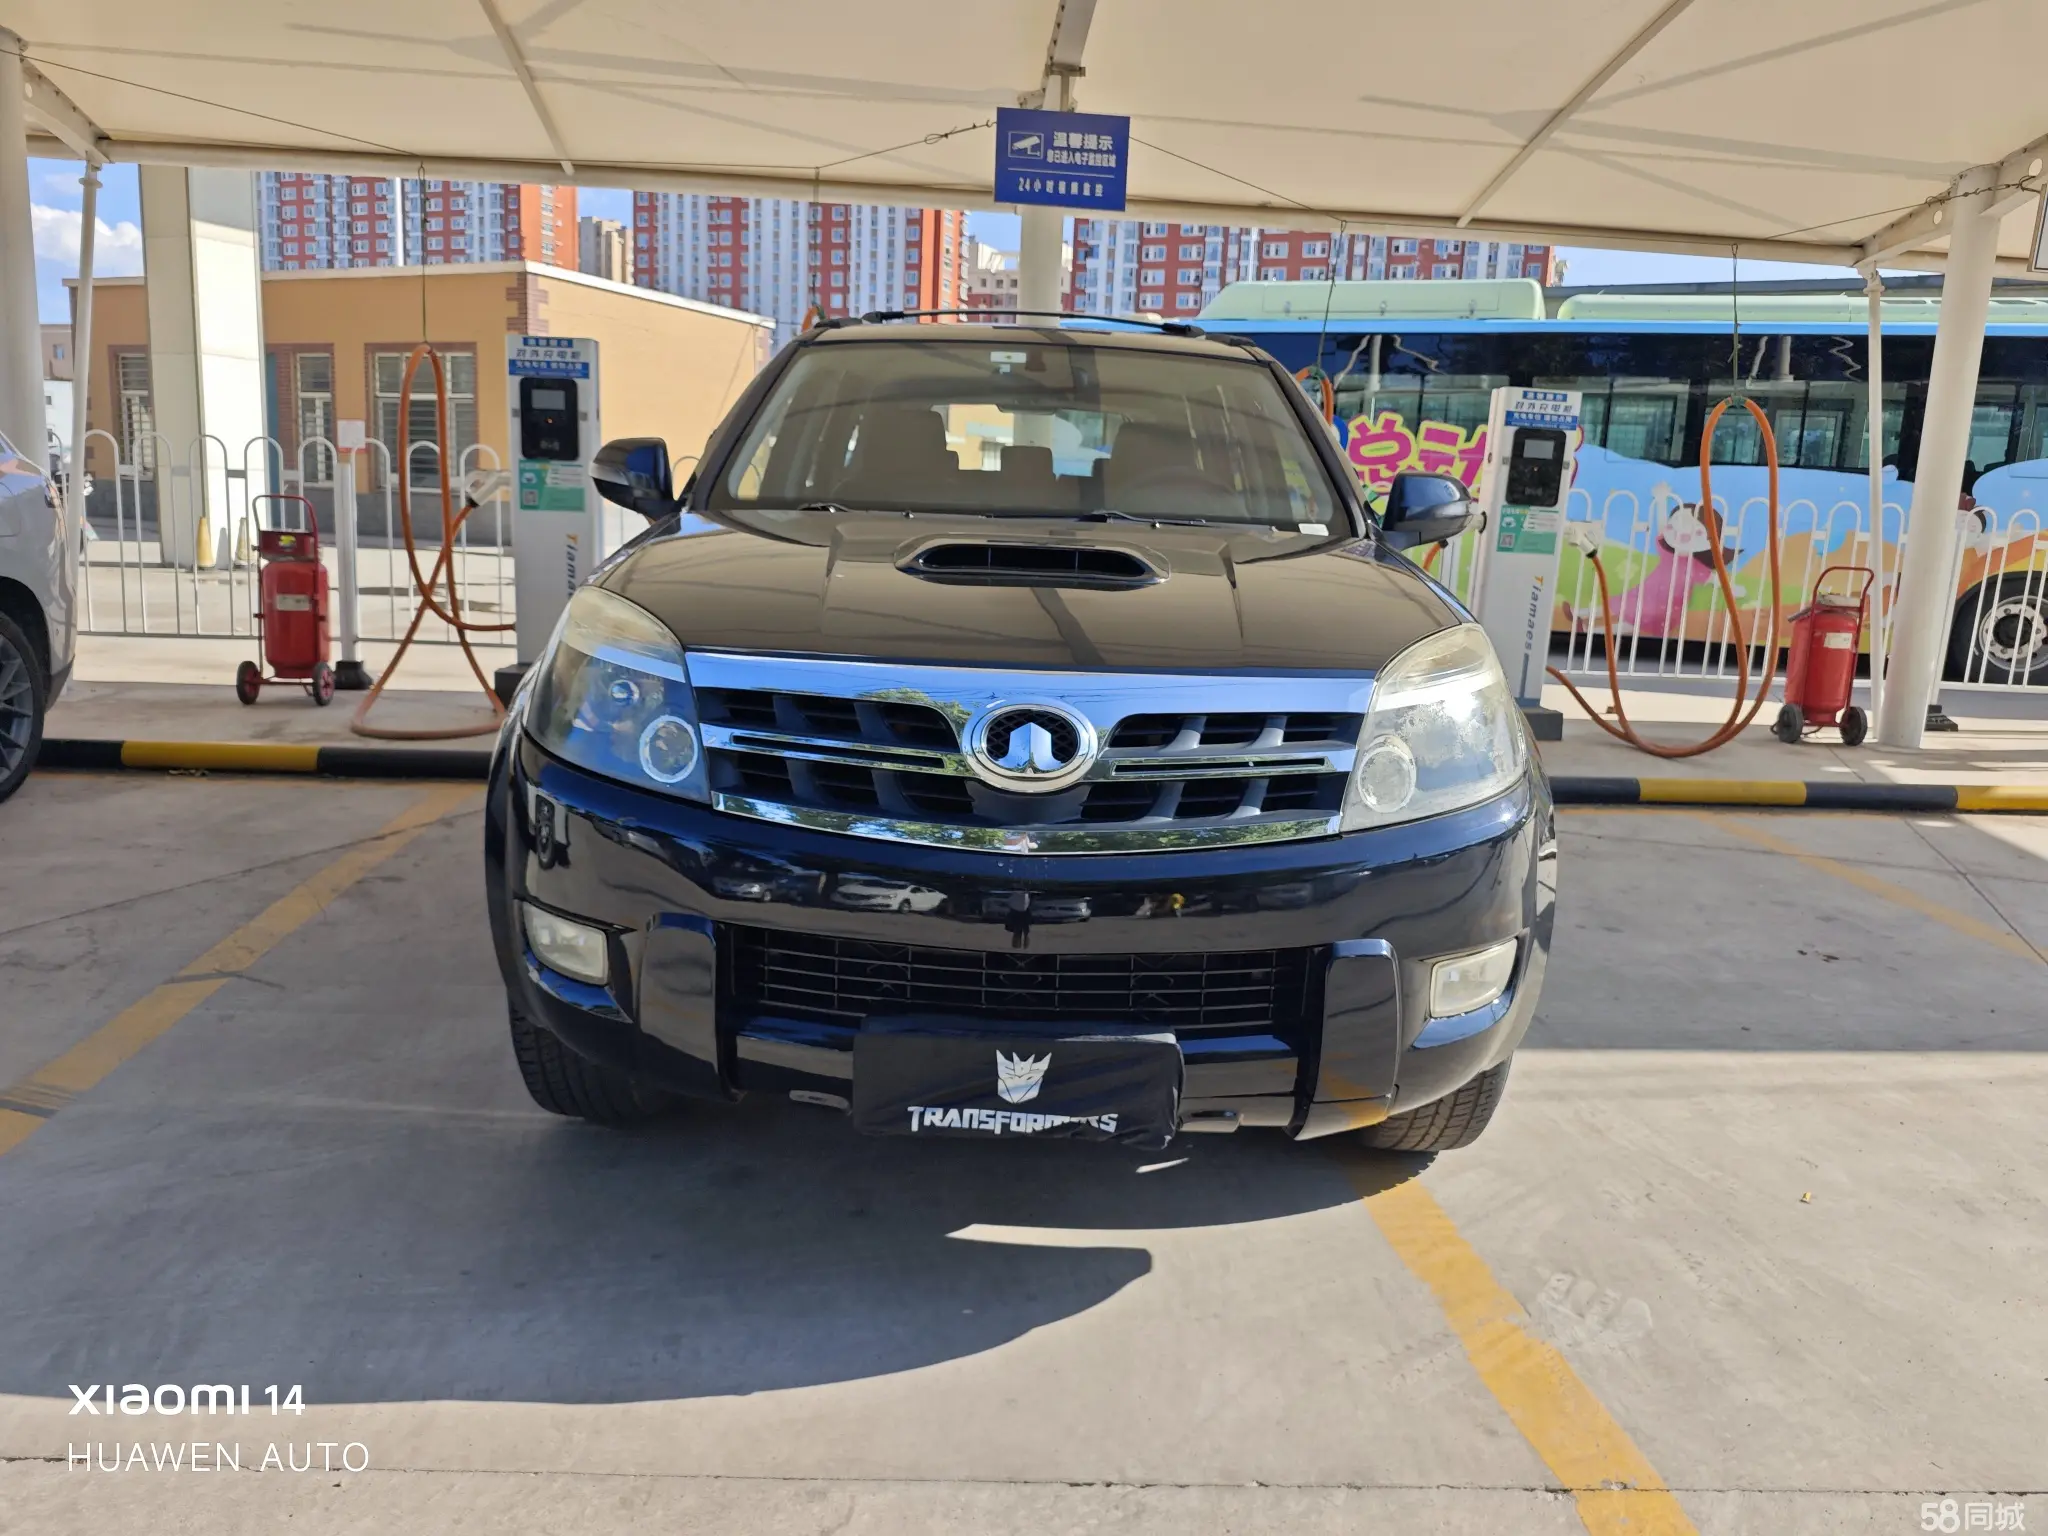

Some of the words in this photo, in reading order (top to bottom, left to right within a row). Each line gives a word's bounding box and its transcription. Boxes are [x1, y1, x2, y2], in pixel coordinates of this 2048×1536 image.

[1052, 131, 1113, 151] 温馨提示
[1525, 575, 1544, 650] Tiamaes
